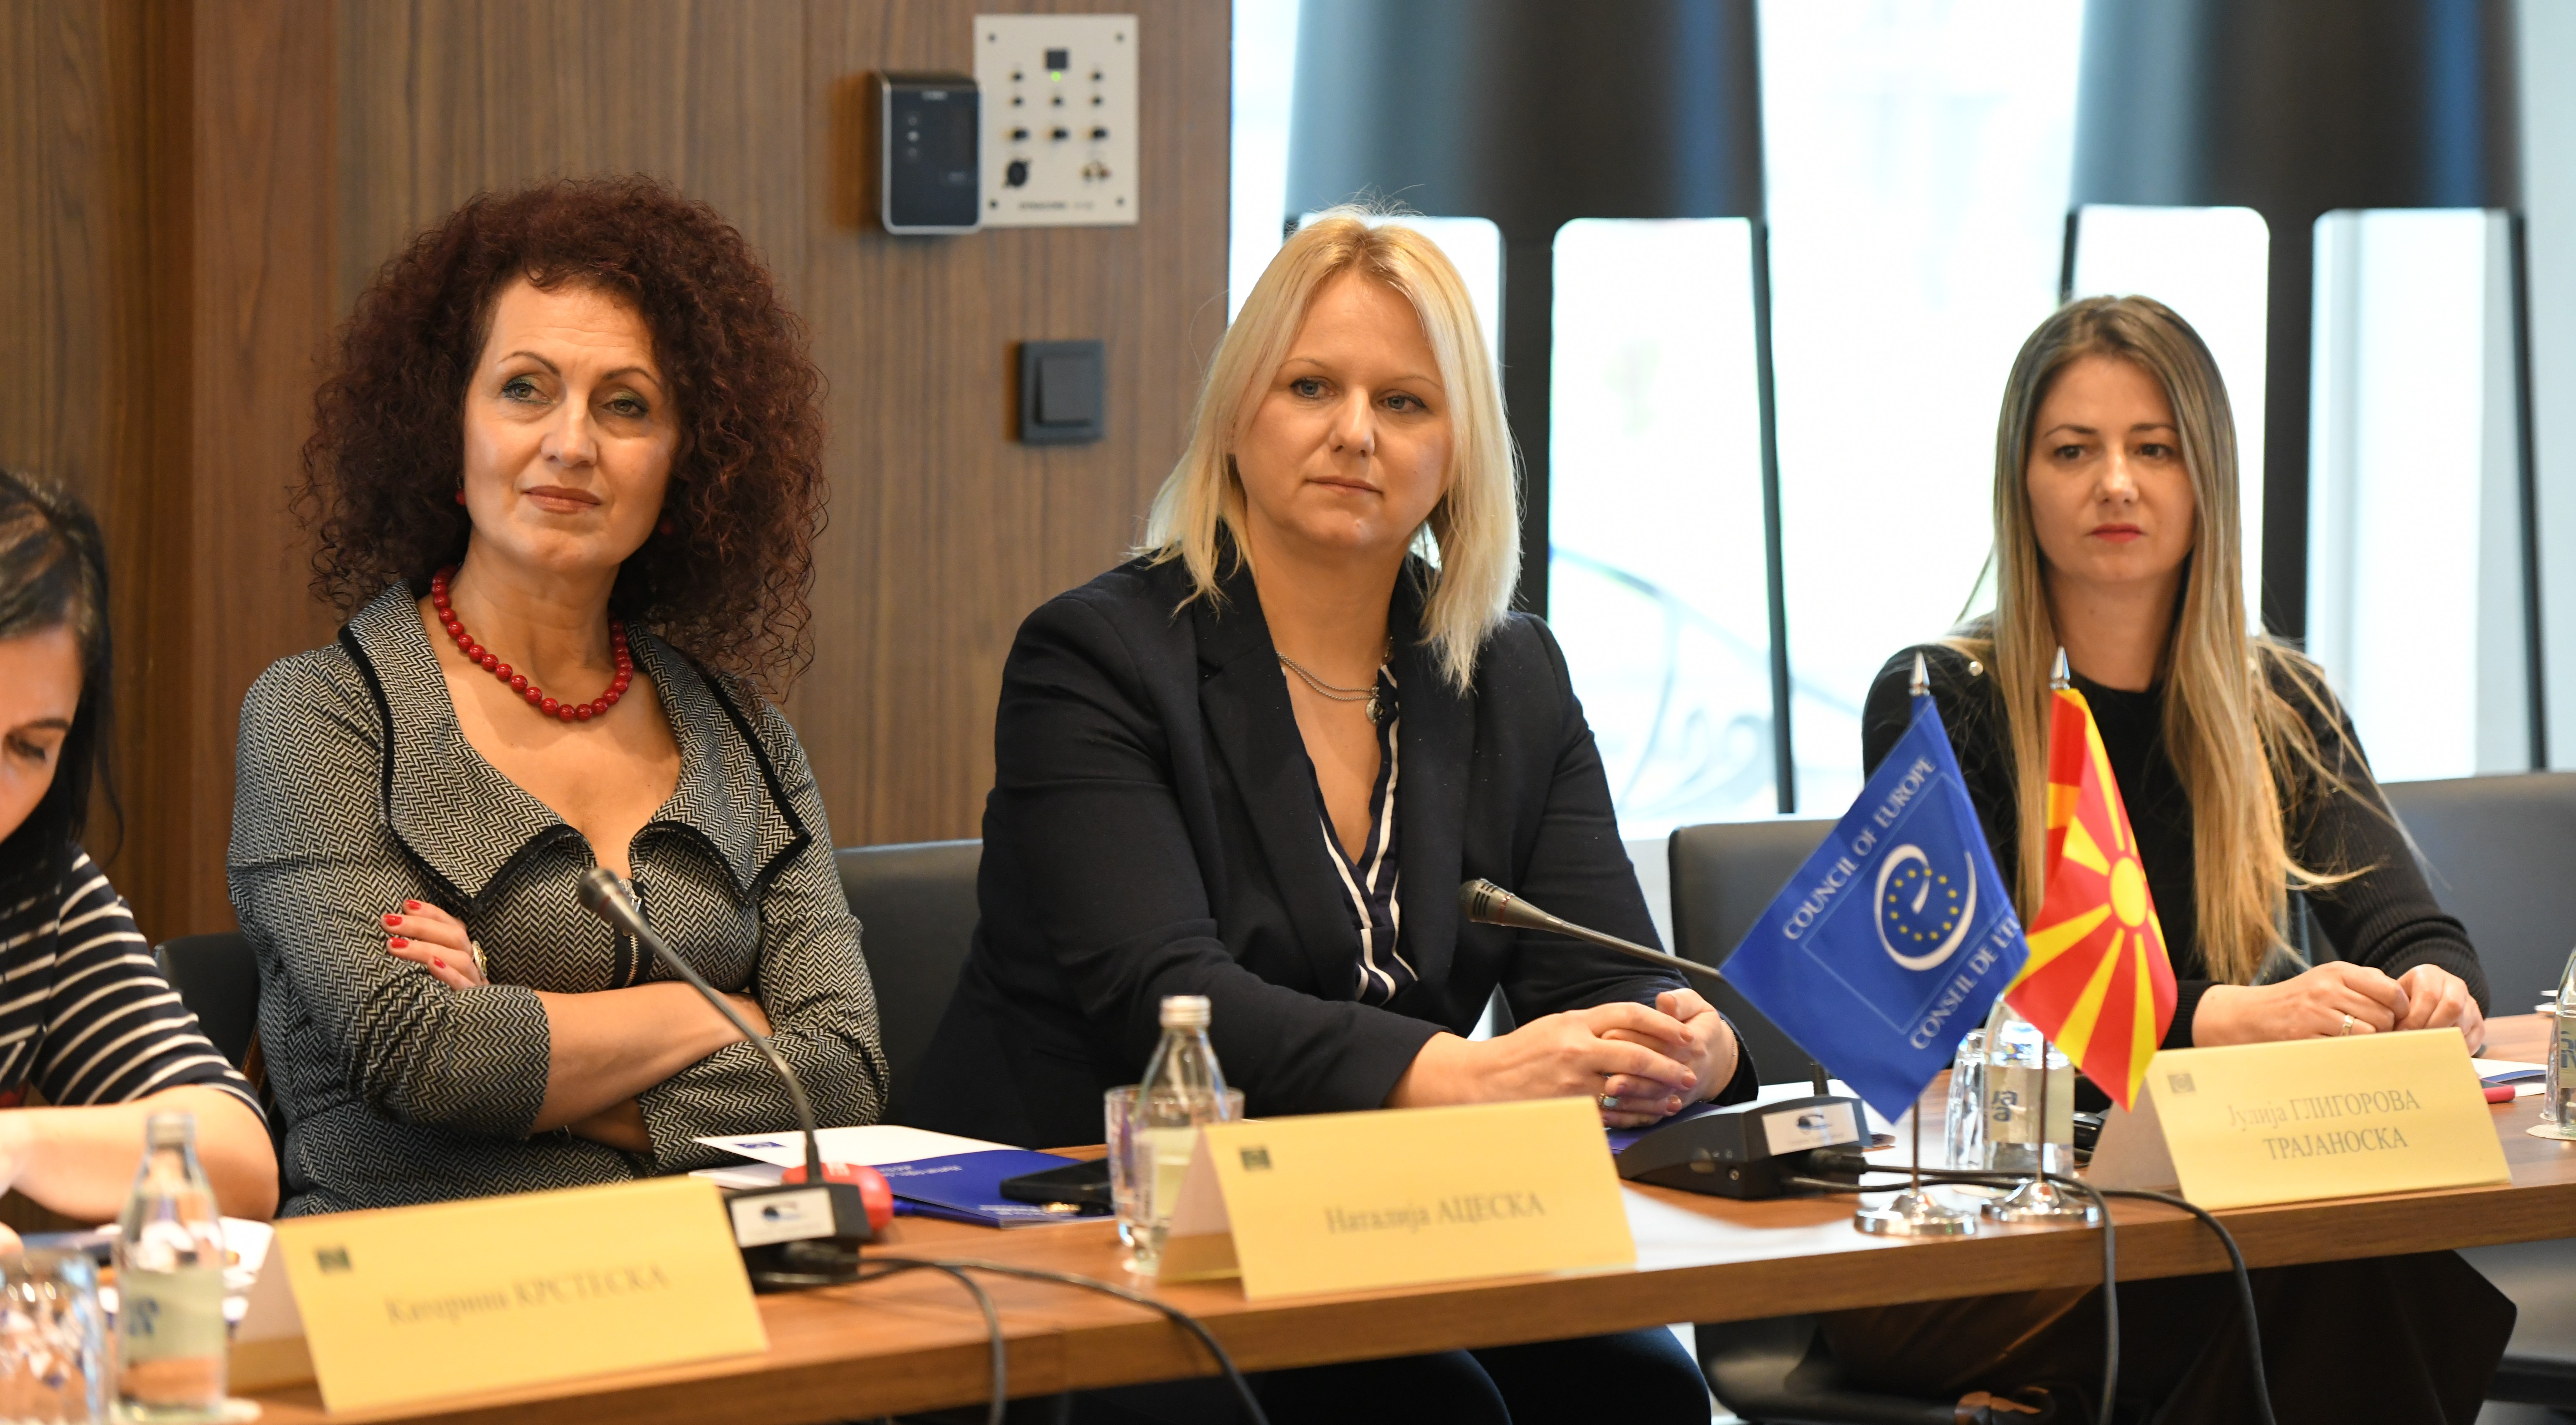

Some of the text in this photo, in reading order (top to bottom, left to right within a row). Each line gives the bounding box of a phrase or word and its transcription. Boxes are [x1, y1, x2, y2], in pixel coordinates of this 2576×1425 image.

[1783, 756, 1936, 939] COUNCIL OF EUROPE
[1910, 974, 1978, 1049] CONSEIL
[1968, 945, 1999, 975] DE
[2289, 1089, 2421, 1120] ГЛИГОРОВА
[2263, 1127, 2409, 1160] ТРАЈАНОСКА
